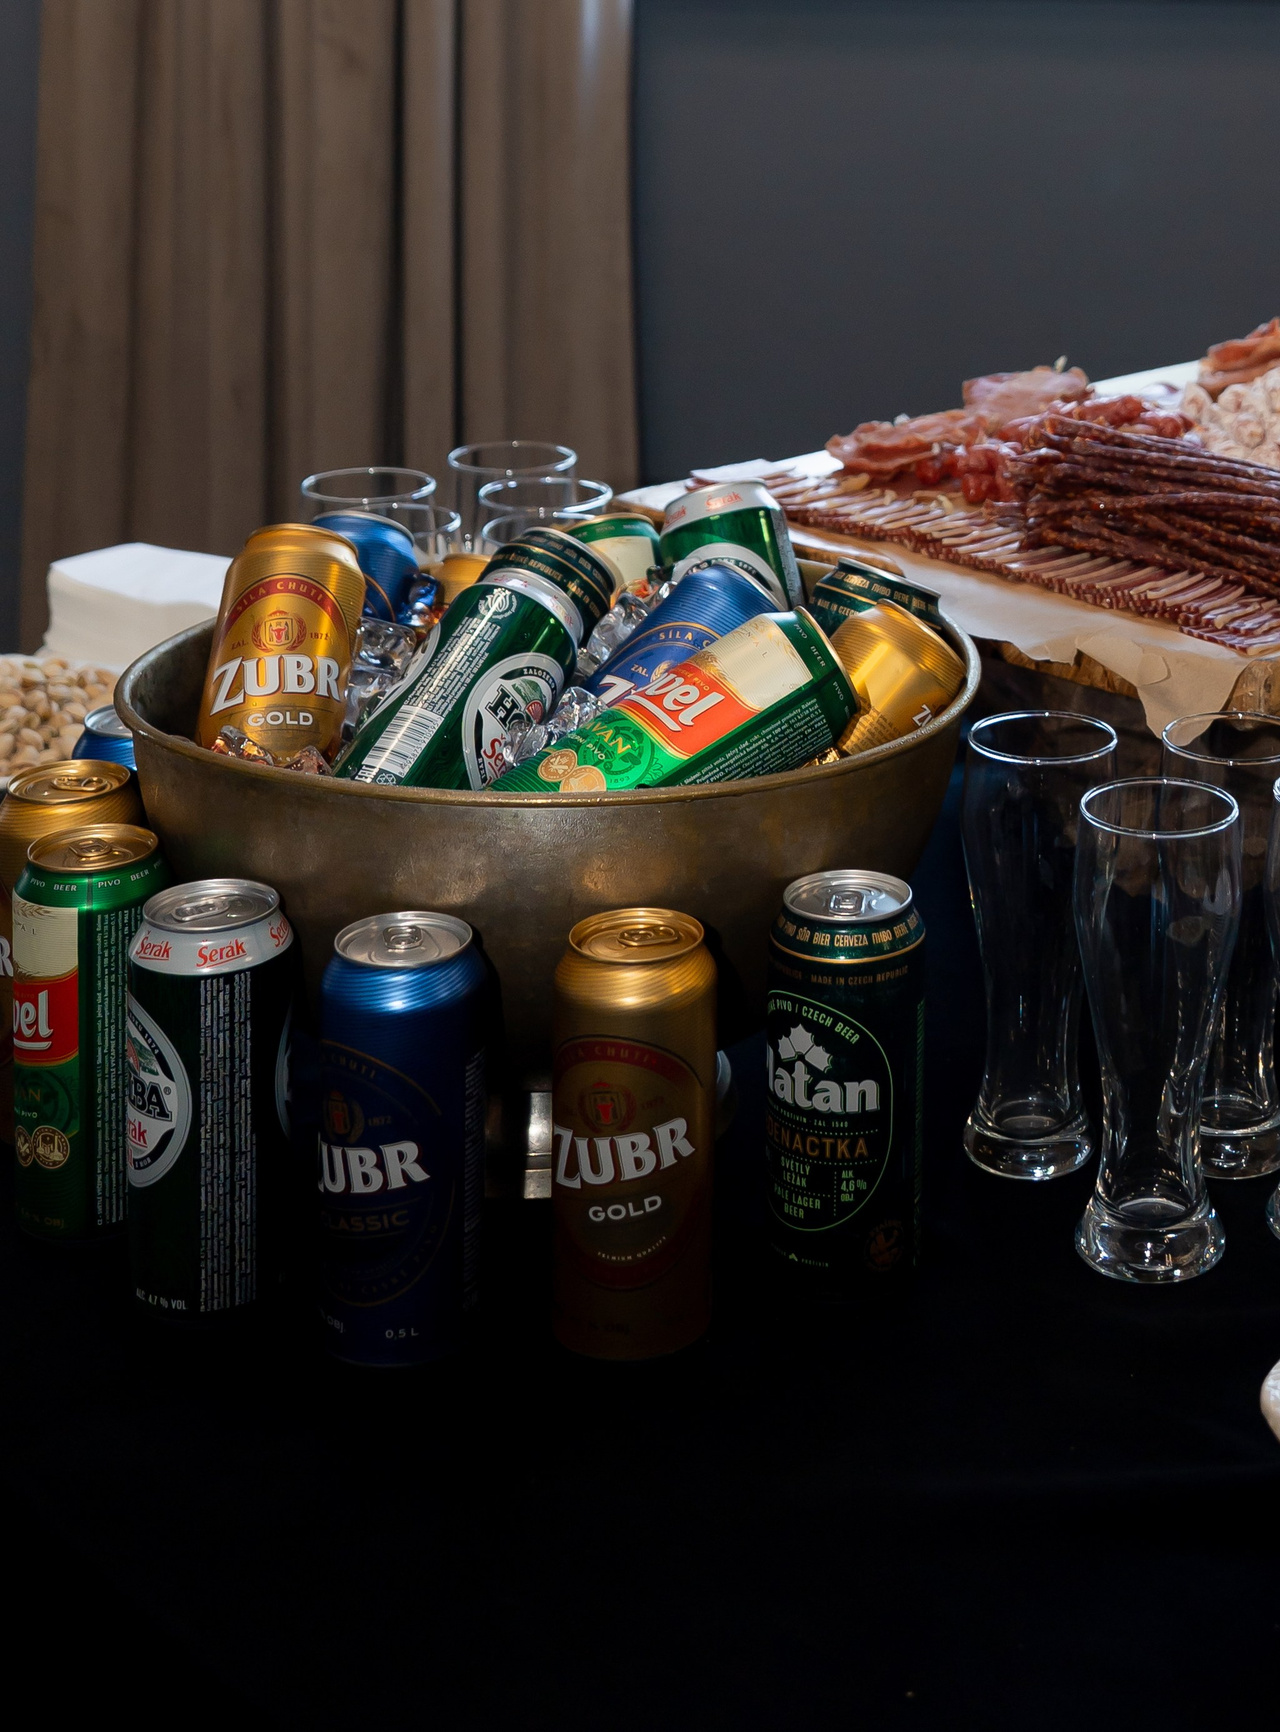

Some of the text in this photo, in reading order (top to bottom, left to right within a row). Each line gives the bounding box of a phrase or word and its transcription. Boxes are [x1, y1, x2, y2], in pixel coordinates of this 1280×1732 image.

[276, 581, 323, 601] CHUTI
[659, 629, 693, 641] SÍLA
[210, 654, 341, 716] ZUBR
[247, 711, 313, 727] GOLD
[29, 877, 46, 888] PIVO
[53, 883, 77, 892] BEER
[97, 878, 121, 889] PIVO
[130, 869, 150, 882] BEER
[136, 931, 172, 958] Šerák
[196, 939, 247, 967] Šerák
[812, 932, 831, 947] BIER
[833, 934, 869, 948] CERVEZA
[810, 973, 833, 985] MADE
[835, 976, 845, 986] IN
[801, 1005, 834, 1028] CZECH
[834, 1021, 860, 1045] BEER
[767, 1041, 881, 1114] latan
[553, 1117, 696, 1190] ZUBR
[319, 1138, 431, 1194] UBR
[856, 1179, 868, 1191] %
[588, 1195, 662, 1222] GOLD
[783, 1202, 805, 1220] BEER
[792, 1192, 821, 1210] LAGER
[324, 1209, 411, 1232] LASSIC
[385, 1328, 406, 1341] 0,5
